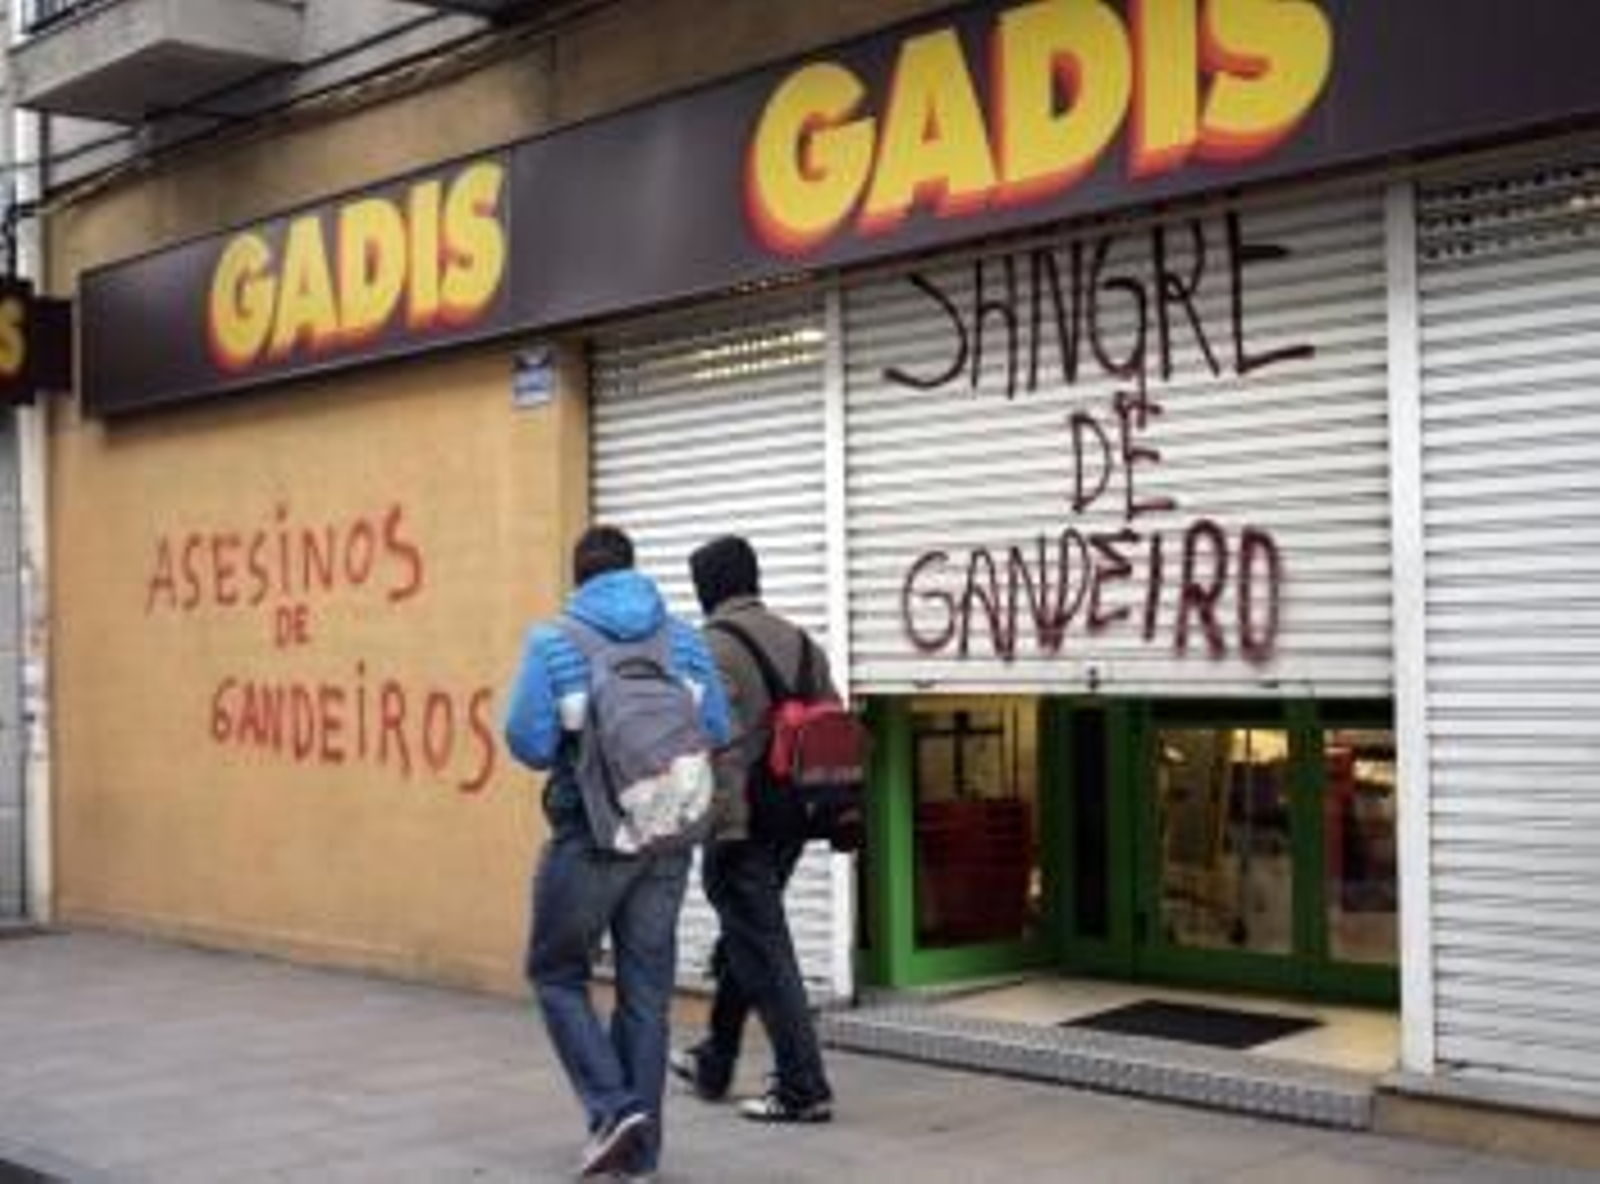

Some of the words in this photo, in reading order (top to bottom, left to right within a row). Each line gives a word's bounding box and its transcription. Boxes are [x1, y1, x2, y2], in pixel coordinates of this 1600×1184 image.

[744, 0, 1333, 256] GADIS
[209, 160, 508, 376] GADIS
[1069, 391, 1178, 520] DE
[275, 604, 311, 648] DE
[903, 519, 1283, 670] GANDEIRO
